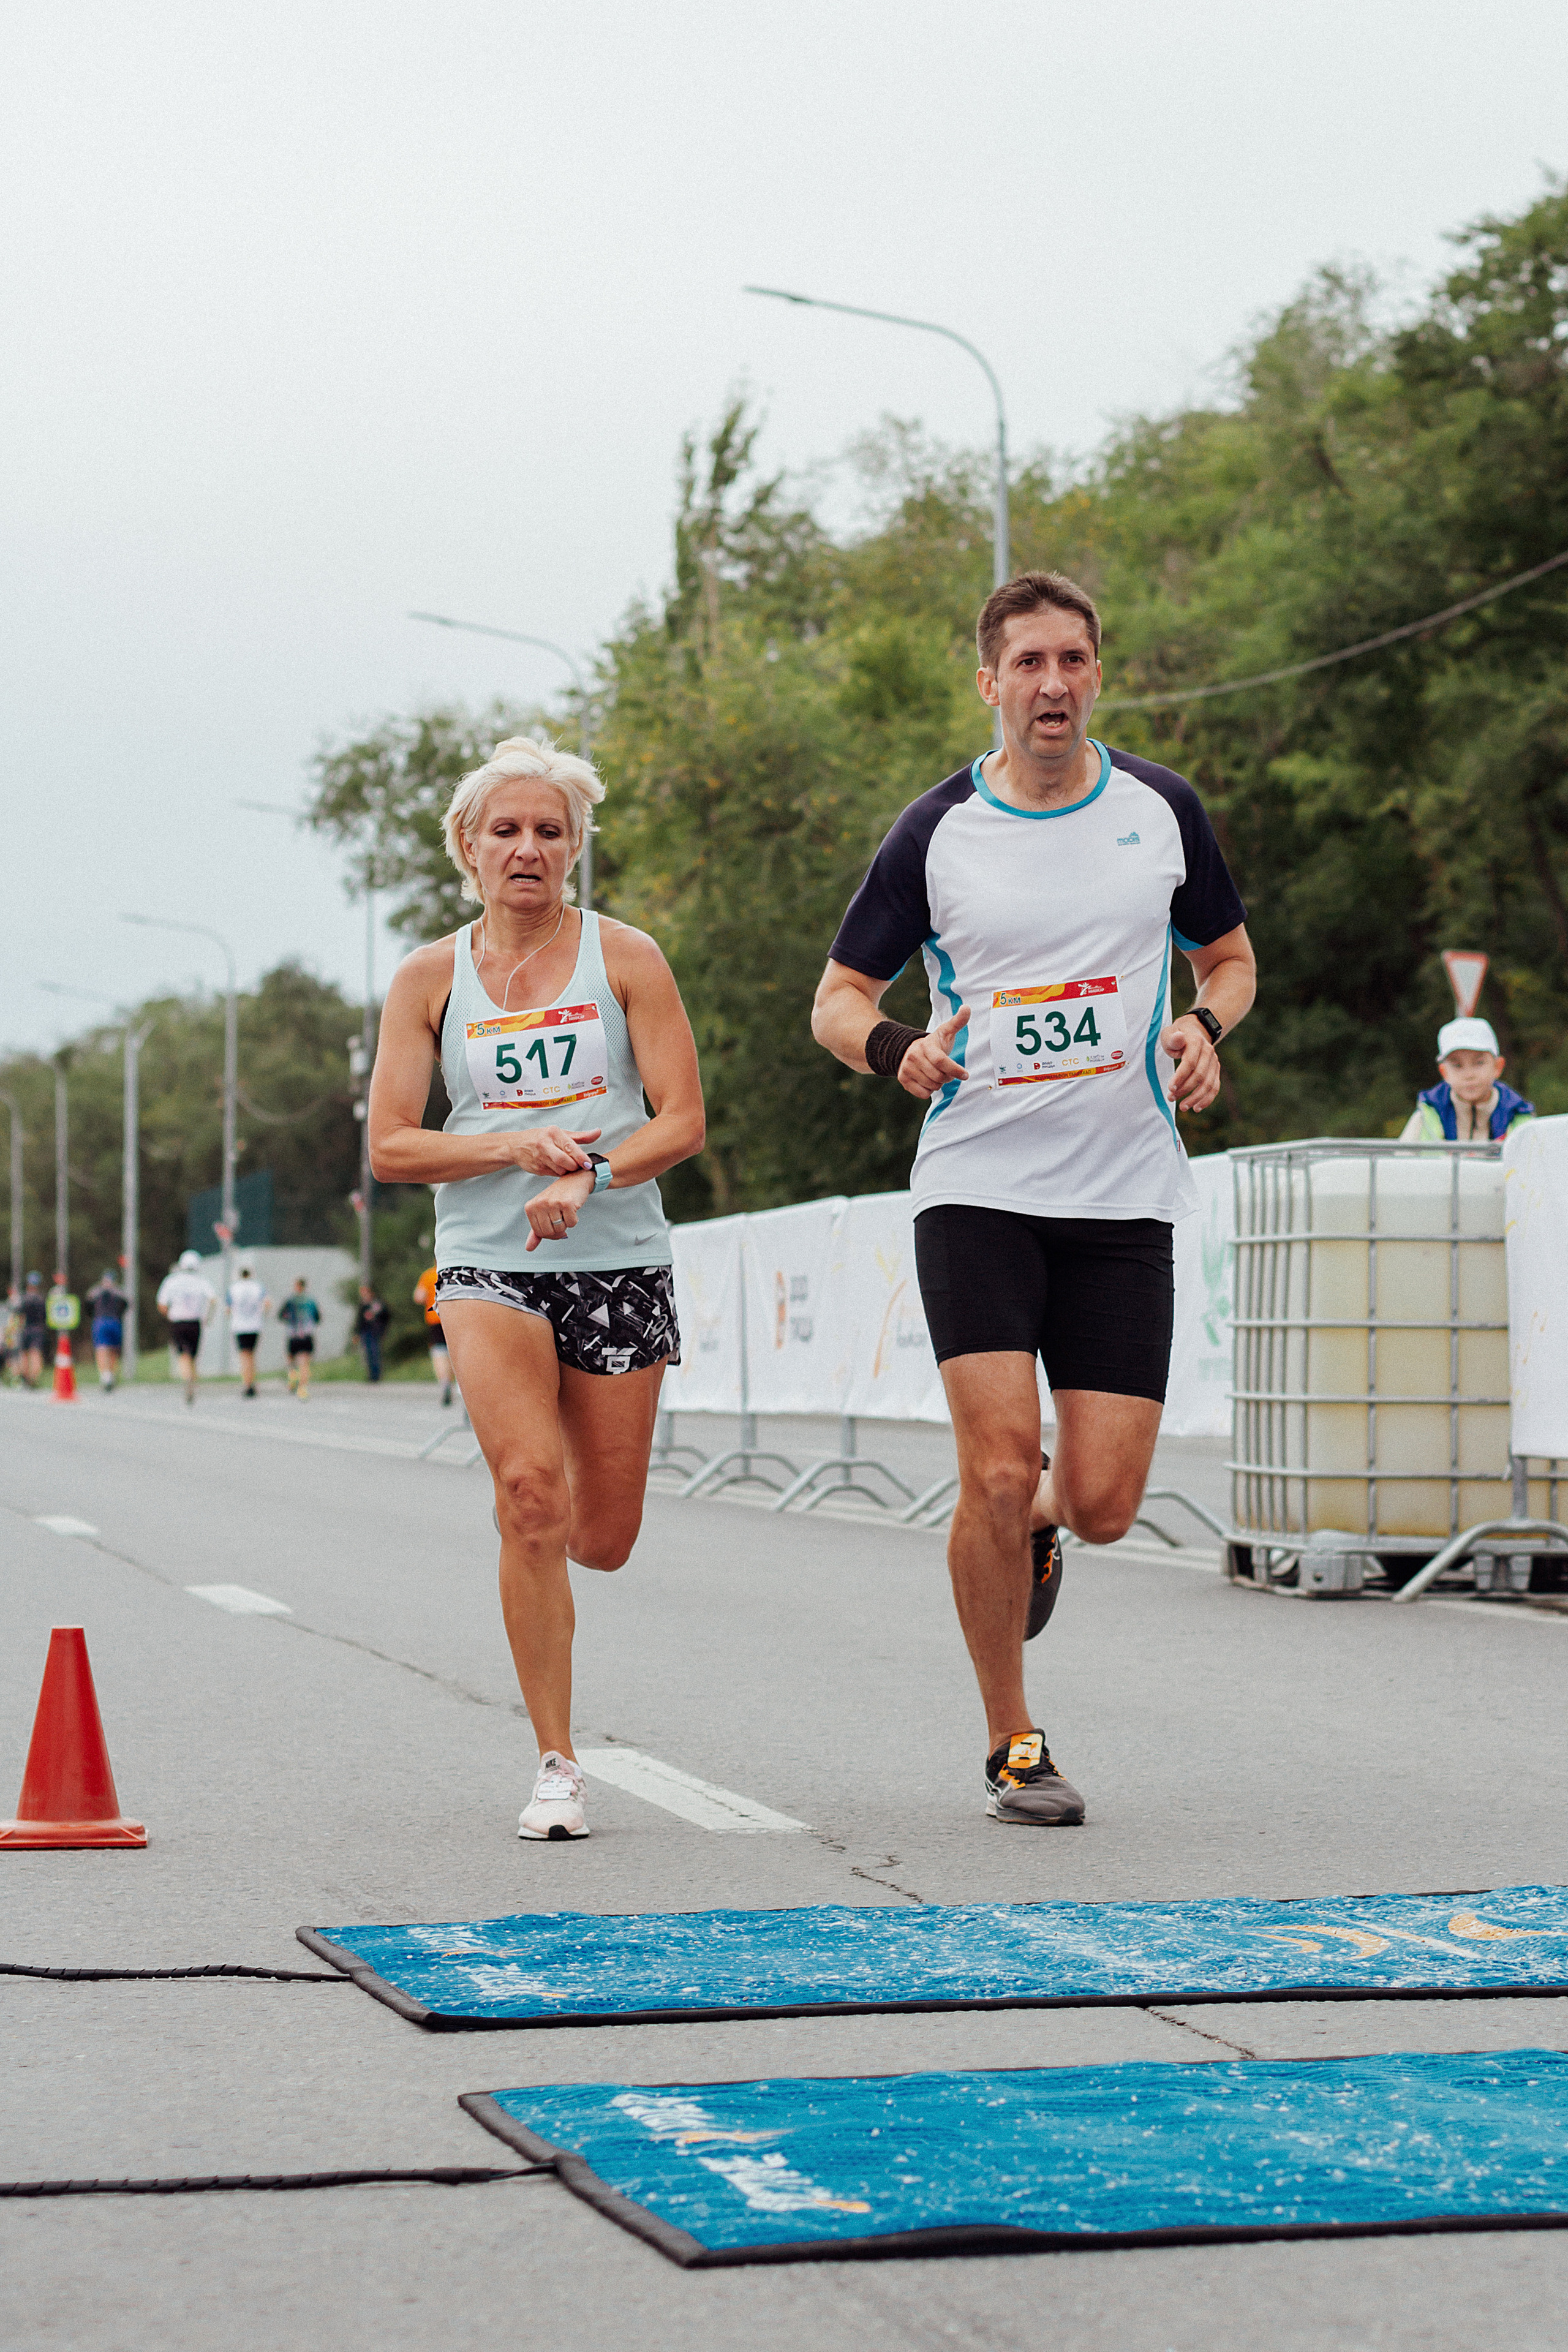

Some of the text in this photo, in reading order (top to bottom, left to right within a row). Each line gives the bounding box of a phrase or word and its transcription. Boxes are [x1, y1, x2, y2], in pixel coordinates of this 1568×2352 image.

[1000, 992, 1007, 1005] 5
[477, 1023, 484, 1035] 5
[1016, 1006, 1101, 1055] 534
[496, 1034, 577, 1084] 517
